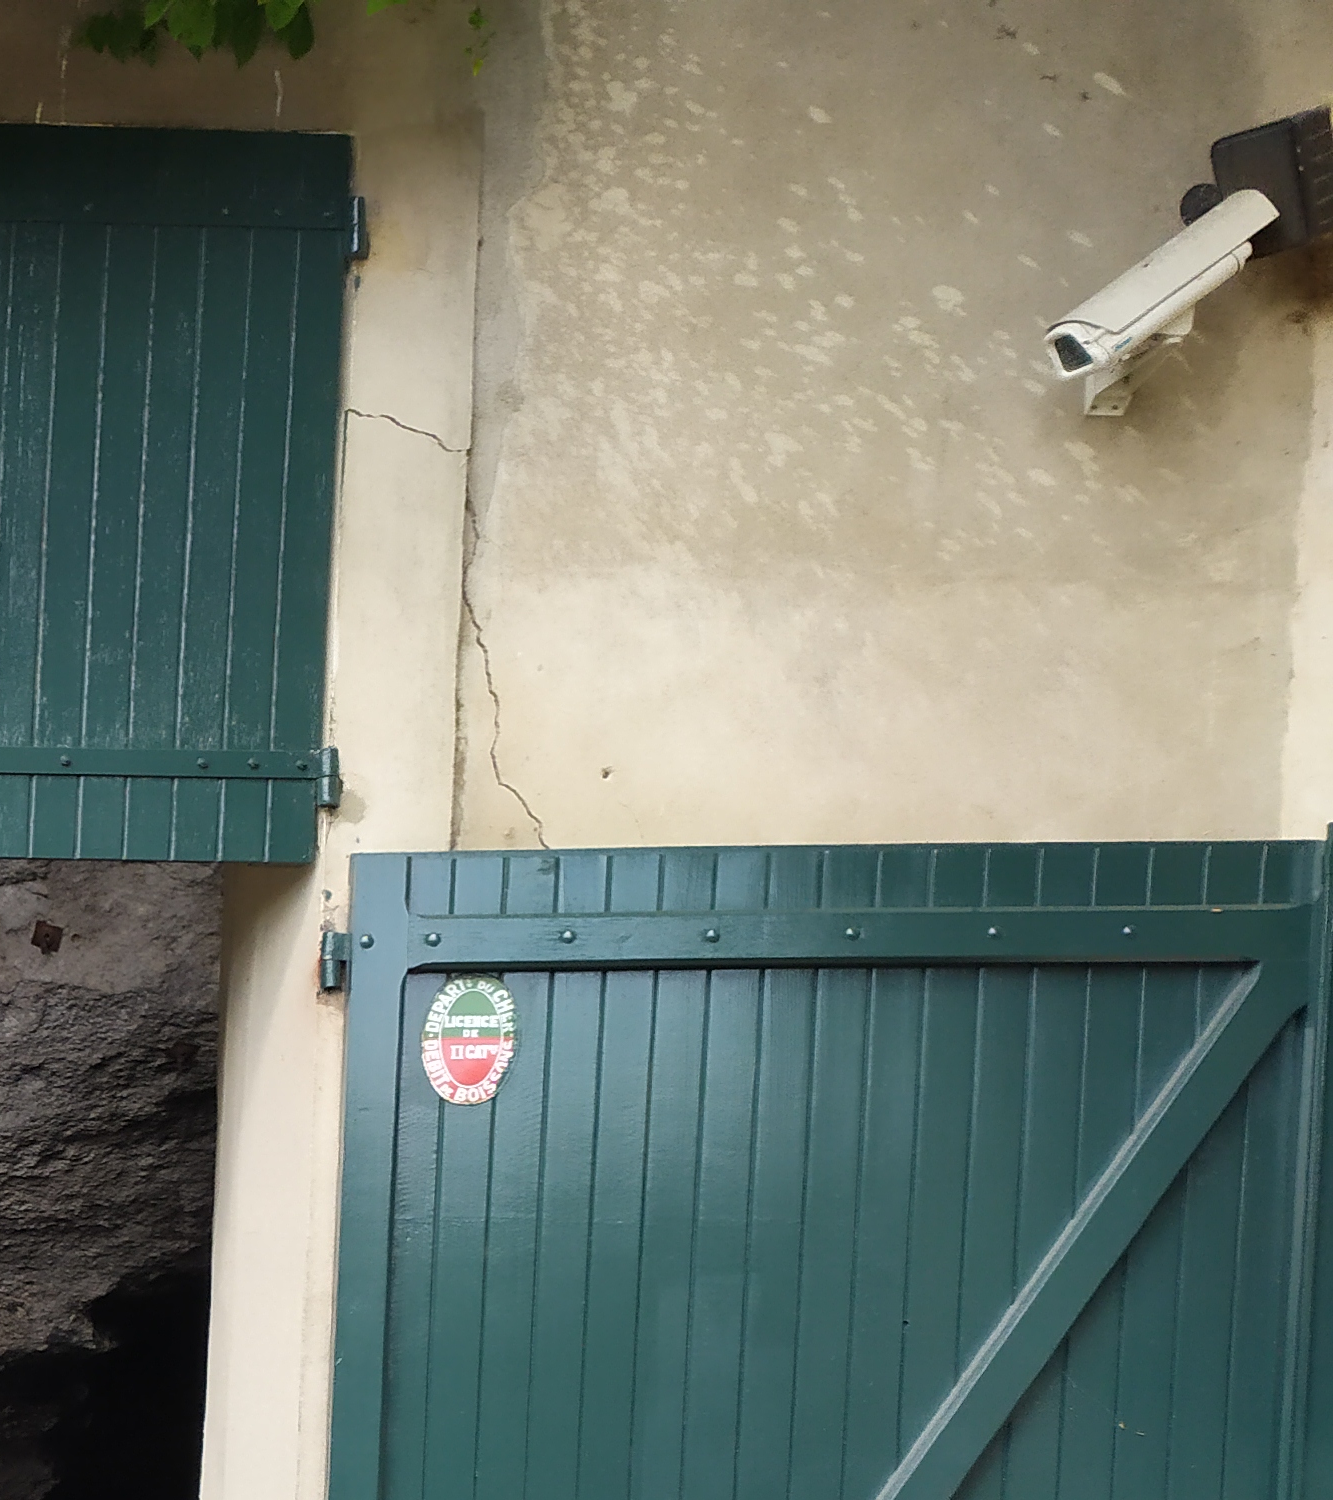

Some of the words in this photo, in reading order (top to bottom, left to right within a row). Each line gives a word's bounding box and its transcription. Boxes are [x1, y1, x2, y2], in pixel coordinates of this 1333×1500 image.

[477, 981, 496, 995] DU
[444, 1015, 499, 1028] LICENCE
[423, 1040, 445, 1085] DEBIT
